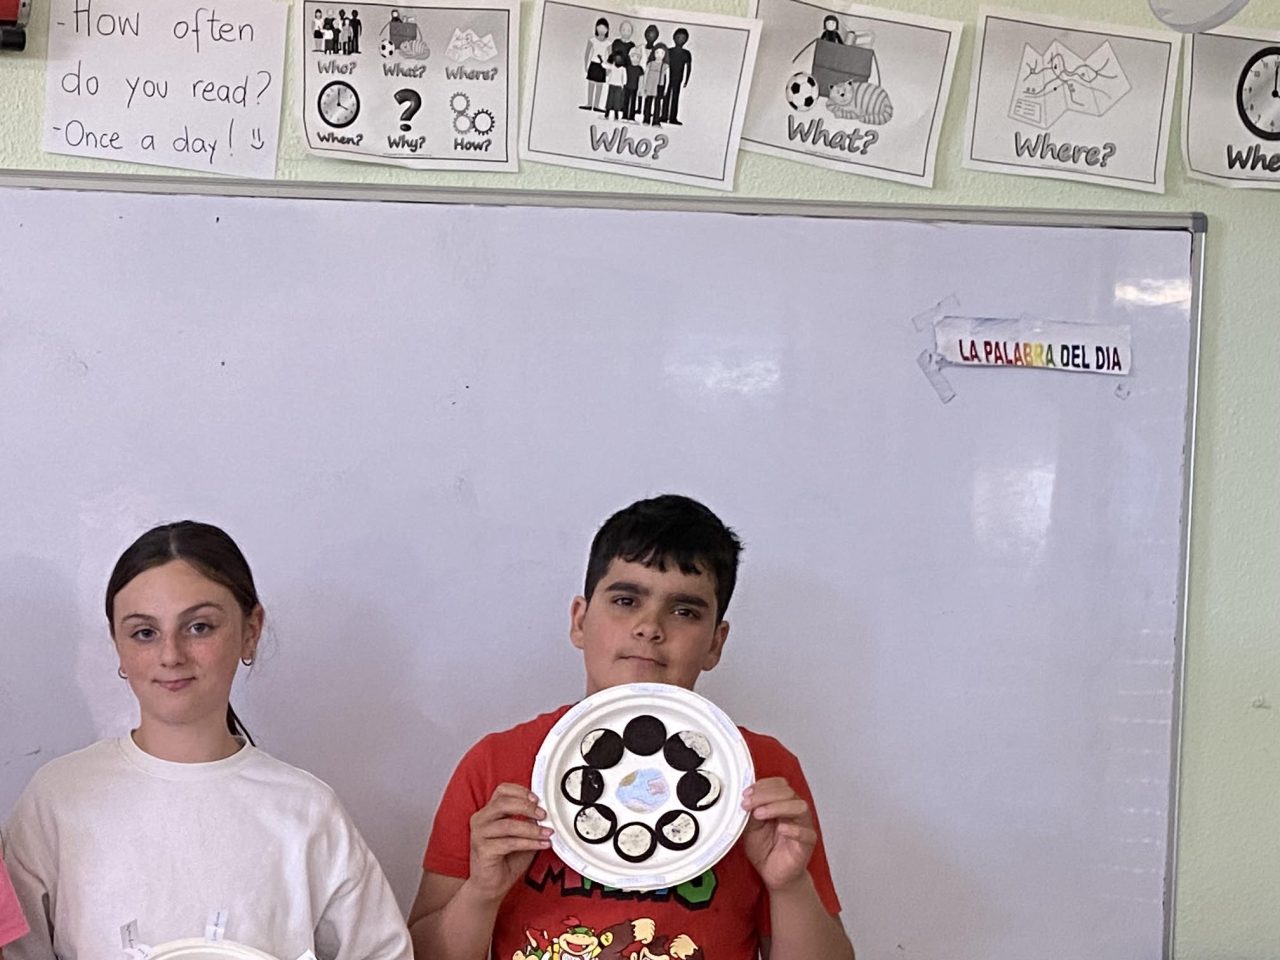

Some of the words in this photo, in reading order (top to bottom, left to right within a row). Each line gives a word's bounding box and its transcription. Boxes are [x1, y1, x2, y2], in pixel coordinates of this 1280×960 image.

[173, 7, 254, 53] often
[317, 60, 357, 75] Who?
[382, 62, 427, 78] What?
[445, 66, 498, 81] Where?
[61, 60, 99, 96] do
[125, 76, 168, 108] you
[192, 70, 272, 107] read?
[141, 134, 155, 151] a
[316, 131, 364, 146] When?
[387, 135, 426, 152] Why?
[589, 124, 669, 160] Who?
[786, 114, 880, 156] What?
[453, 137, 492, 151] How?
[1014, 131, 1117, 168] Where?
[958, 339, 981, 363] LA
[984, 341, 1056, 367] PALABRA
[1060, 344, 1090, 369] DEL
[1095, 346, 1122, 371] DIA
